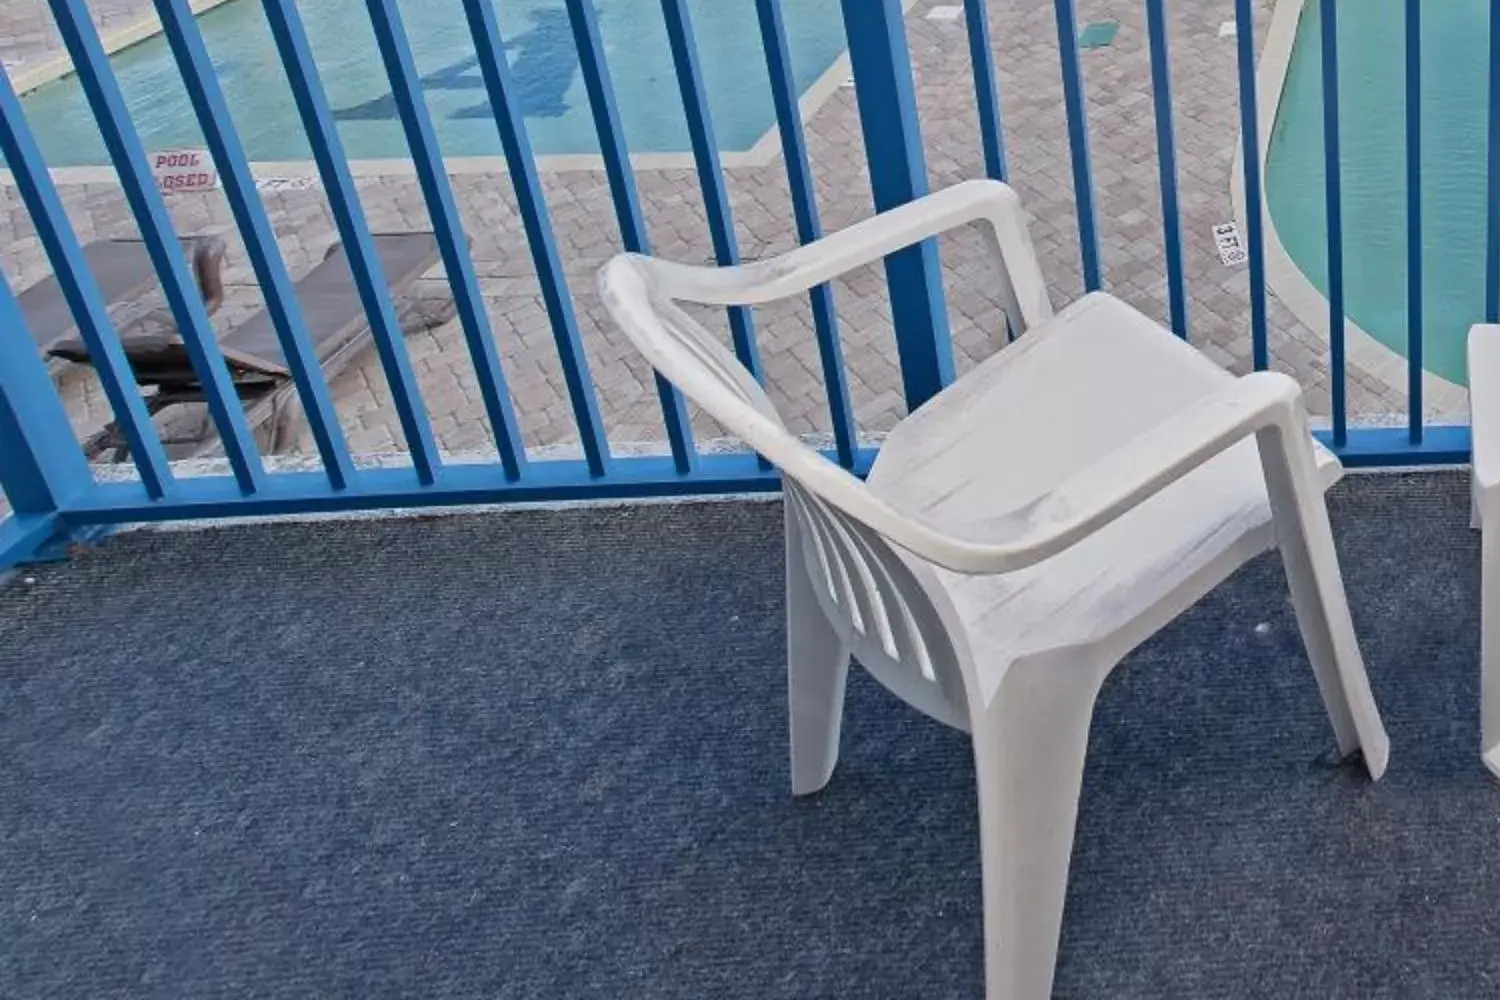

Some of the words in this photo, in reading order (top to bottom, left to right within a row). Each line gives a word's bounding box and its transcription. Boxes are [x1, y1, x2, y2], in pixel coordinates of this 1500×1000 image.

[155, 154, 200, 168] POOL
[160, 173, 208, 190] OSED
[1216, 226, 1233, 235] 3
